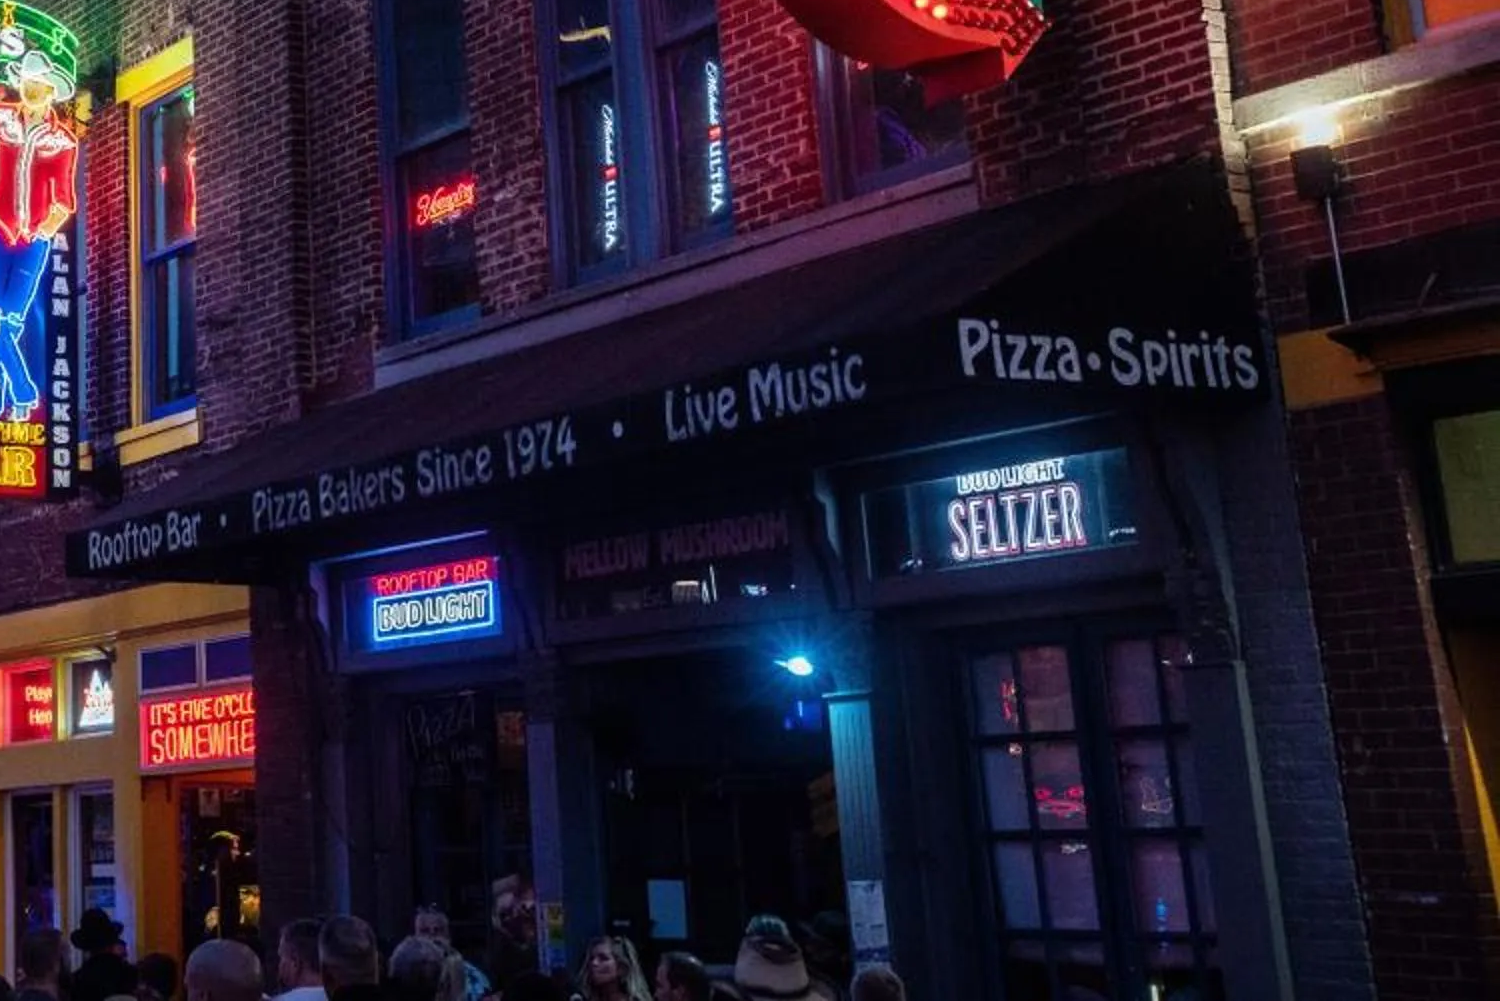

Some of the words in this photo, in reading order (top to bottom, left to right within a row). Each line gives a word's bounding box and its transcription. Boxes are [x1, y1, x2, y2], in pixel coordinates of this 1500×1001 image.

[709, 140, 724, 213] ULTRA
[605, 180, 617, 251] ULTRA
[52, 232, 69, 317] ALAN
[958, 318, 1083, 382] Pizza
[1108, 327, 1259, 389] Spirits
[53, 336, 71, 488] JACKSON
[88, 520, 163, 570] Rooftop
[167, 510, 201, 551] Bar
[252, 486, 311, 534] Pizza
[318, 465, 405, 518] Bakers
[417, 444, 492, 496] Since
[504, 415, 577, 479] 1974
[665, 384, 738, 441] Live
[749, 347, 867, 423] Music
[957, 468, 1001, 494] BUD
[1001, 458, 1066, 489] LIGHT
[948, 482, 1088, 563] SELTZER
[377, 568, 448, 596] ROOFTOP
[453, 560, 488, 584] BAR
[378, 600, 422, 632] BUD
[424, 589, 487, 625] LIGHT
[151, 702, 177, 726] IT'S
[180, 697, 213, 722] FIVE
